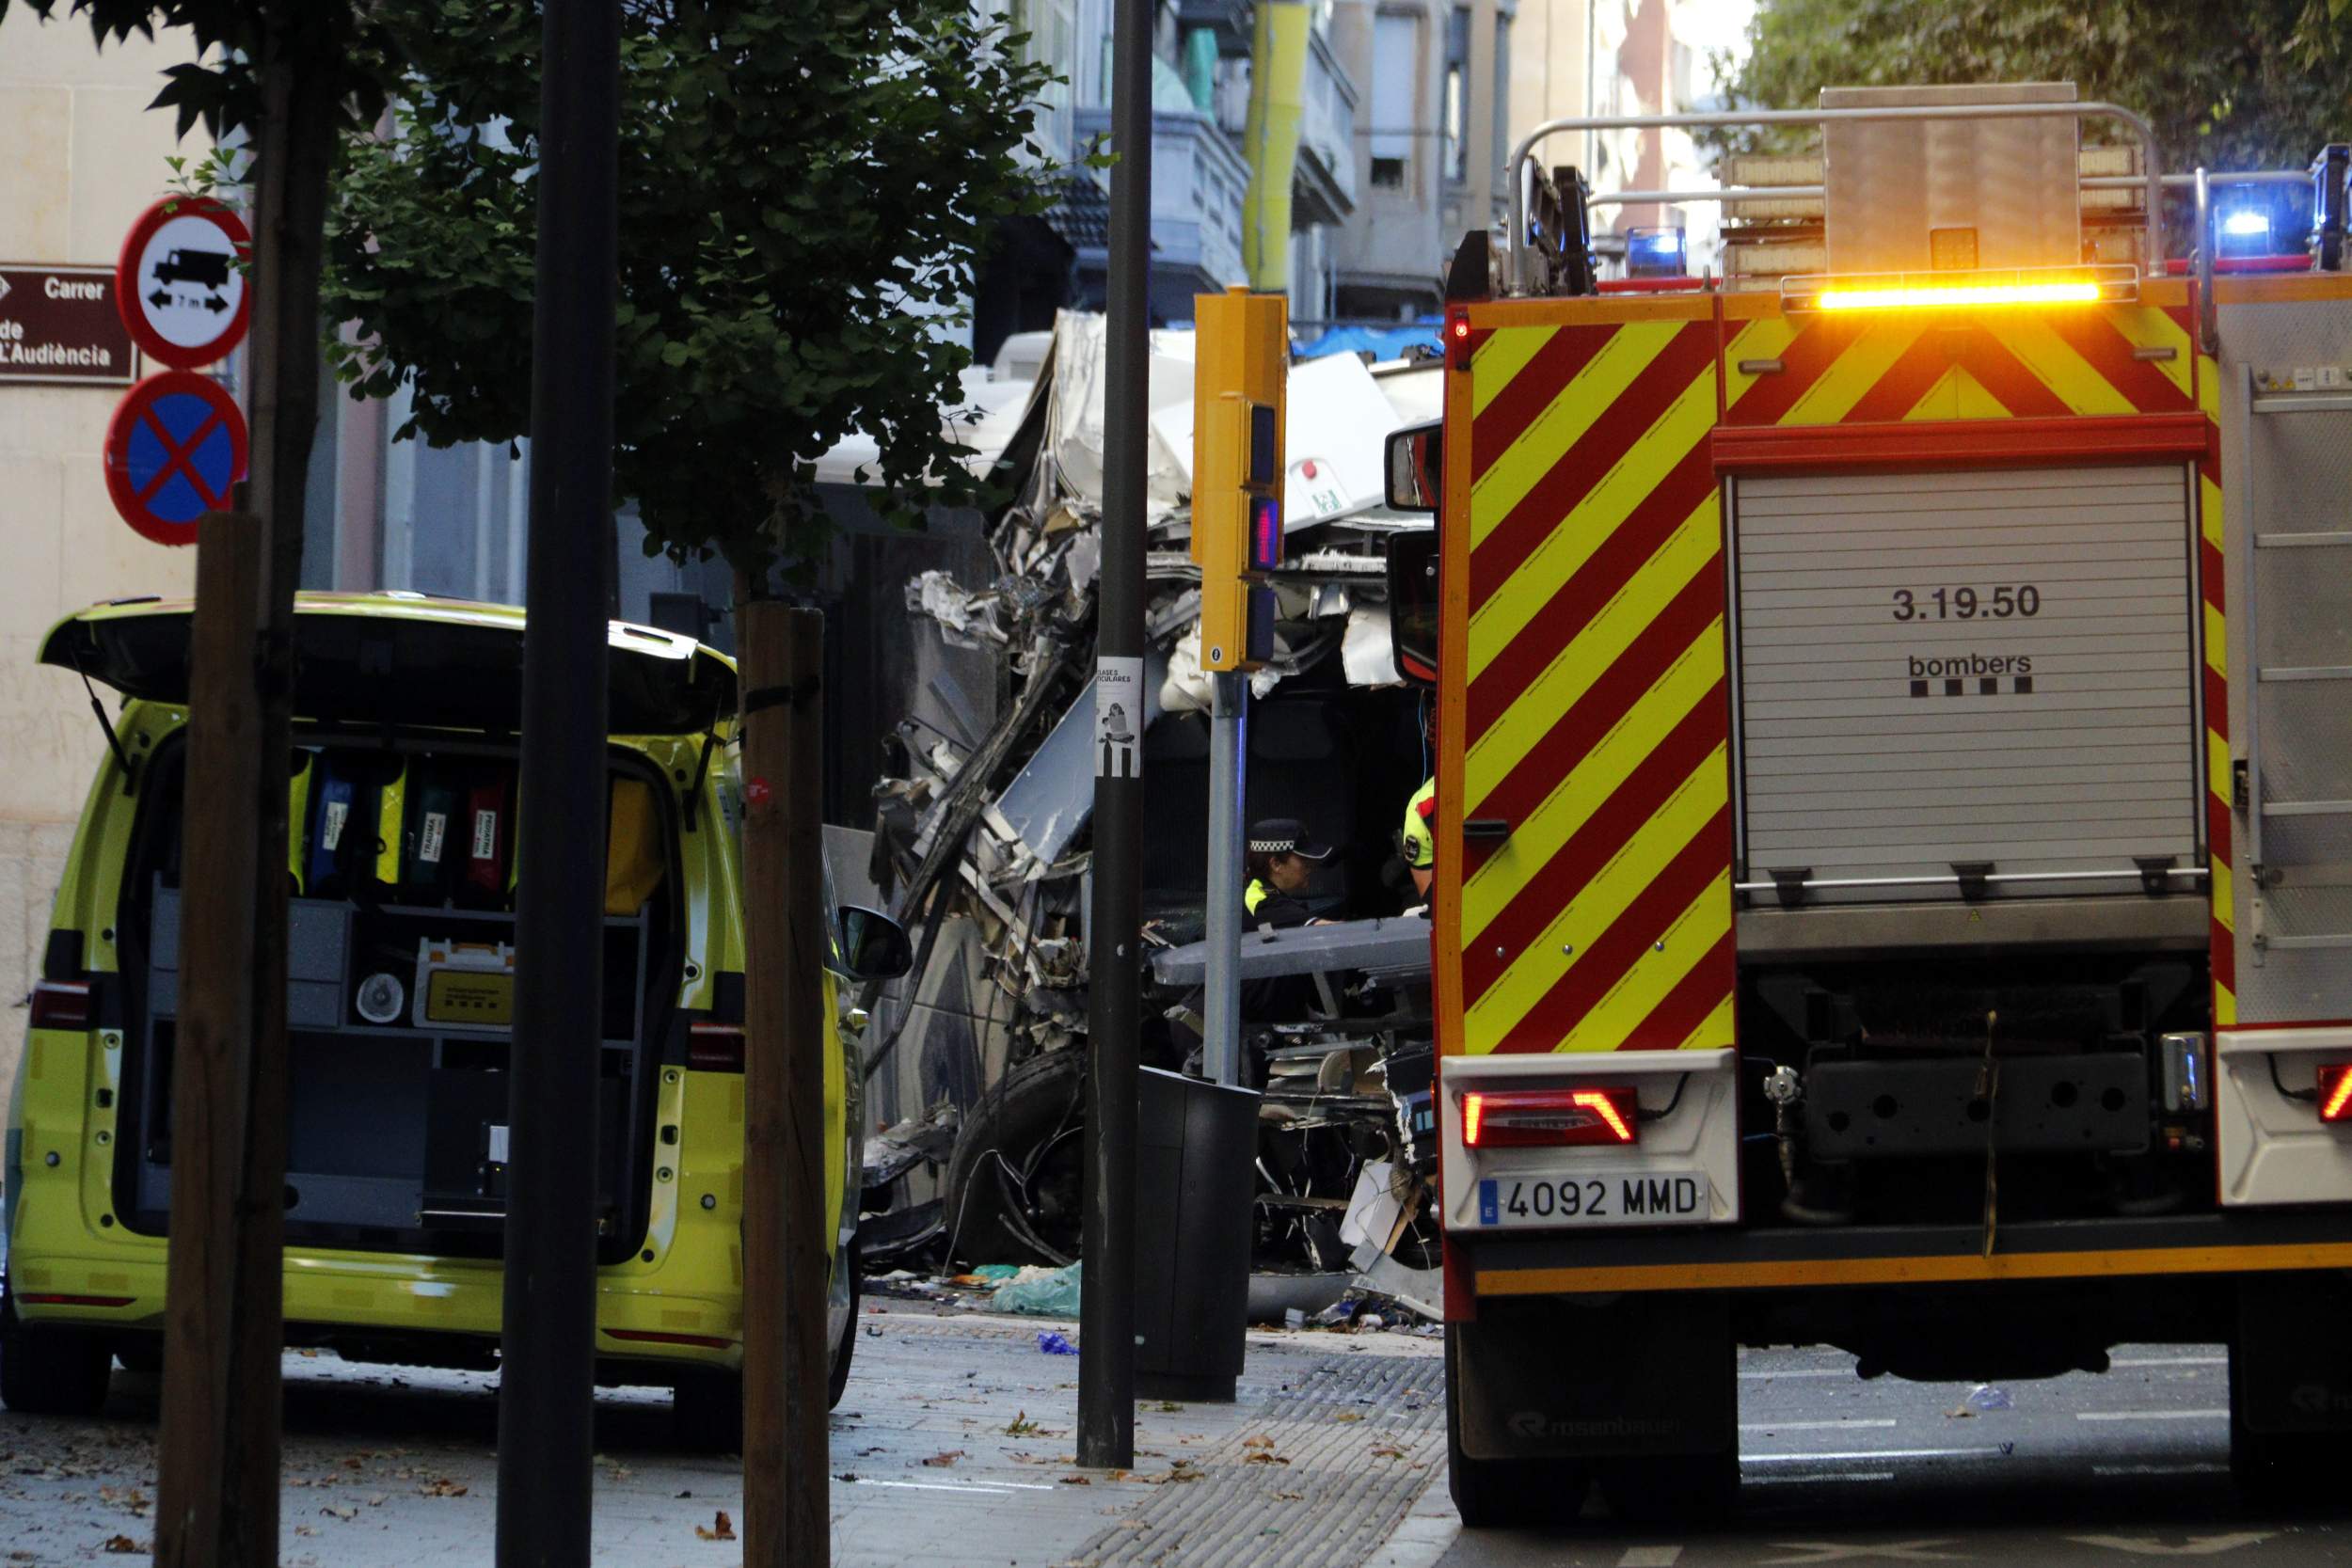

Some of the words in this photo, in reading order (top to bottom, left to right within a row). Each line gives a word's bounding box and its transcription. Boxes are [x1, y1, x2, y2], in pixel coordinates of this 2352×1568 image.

[44, 277, 105, 300] Carrer
[1893, 585, 2040, 622] 3.19.50
[1909, 653, 2032, 677] bombers
[424, 818, 437, 855] TRAUMA
[1485, 1207, 1493, 1217] E
[1508, 1180, 1607, 1217] 4092
[1623, 1178, 1696, 1215] MMD
